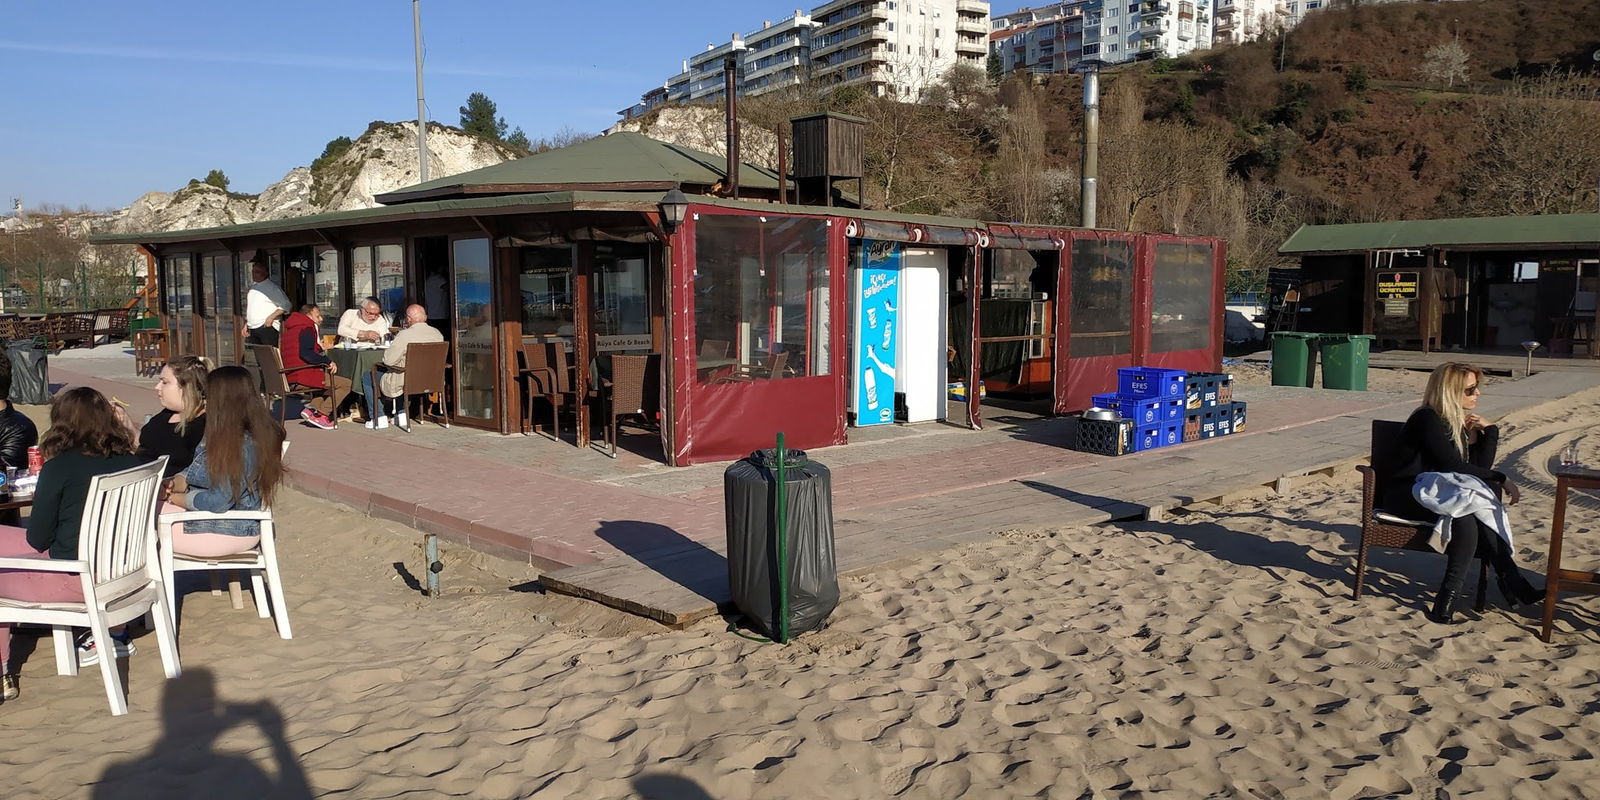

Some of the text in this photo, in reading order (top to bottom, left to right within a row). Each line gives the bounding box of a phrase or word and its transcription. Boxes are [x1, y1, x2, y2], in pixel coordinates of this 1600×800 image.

[870, 240, 896, 256] Ayran
[634, 338, 650, 346] Beach
[1132, 382, 1148, 390] EFES
[1205, 392, 1216, 401] EFES
[1204, 422, 1215, 432] EFES
[1218, 420, 1229, 430] EFES
